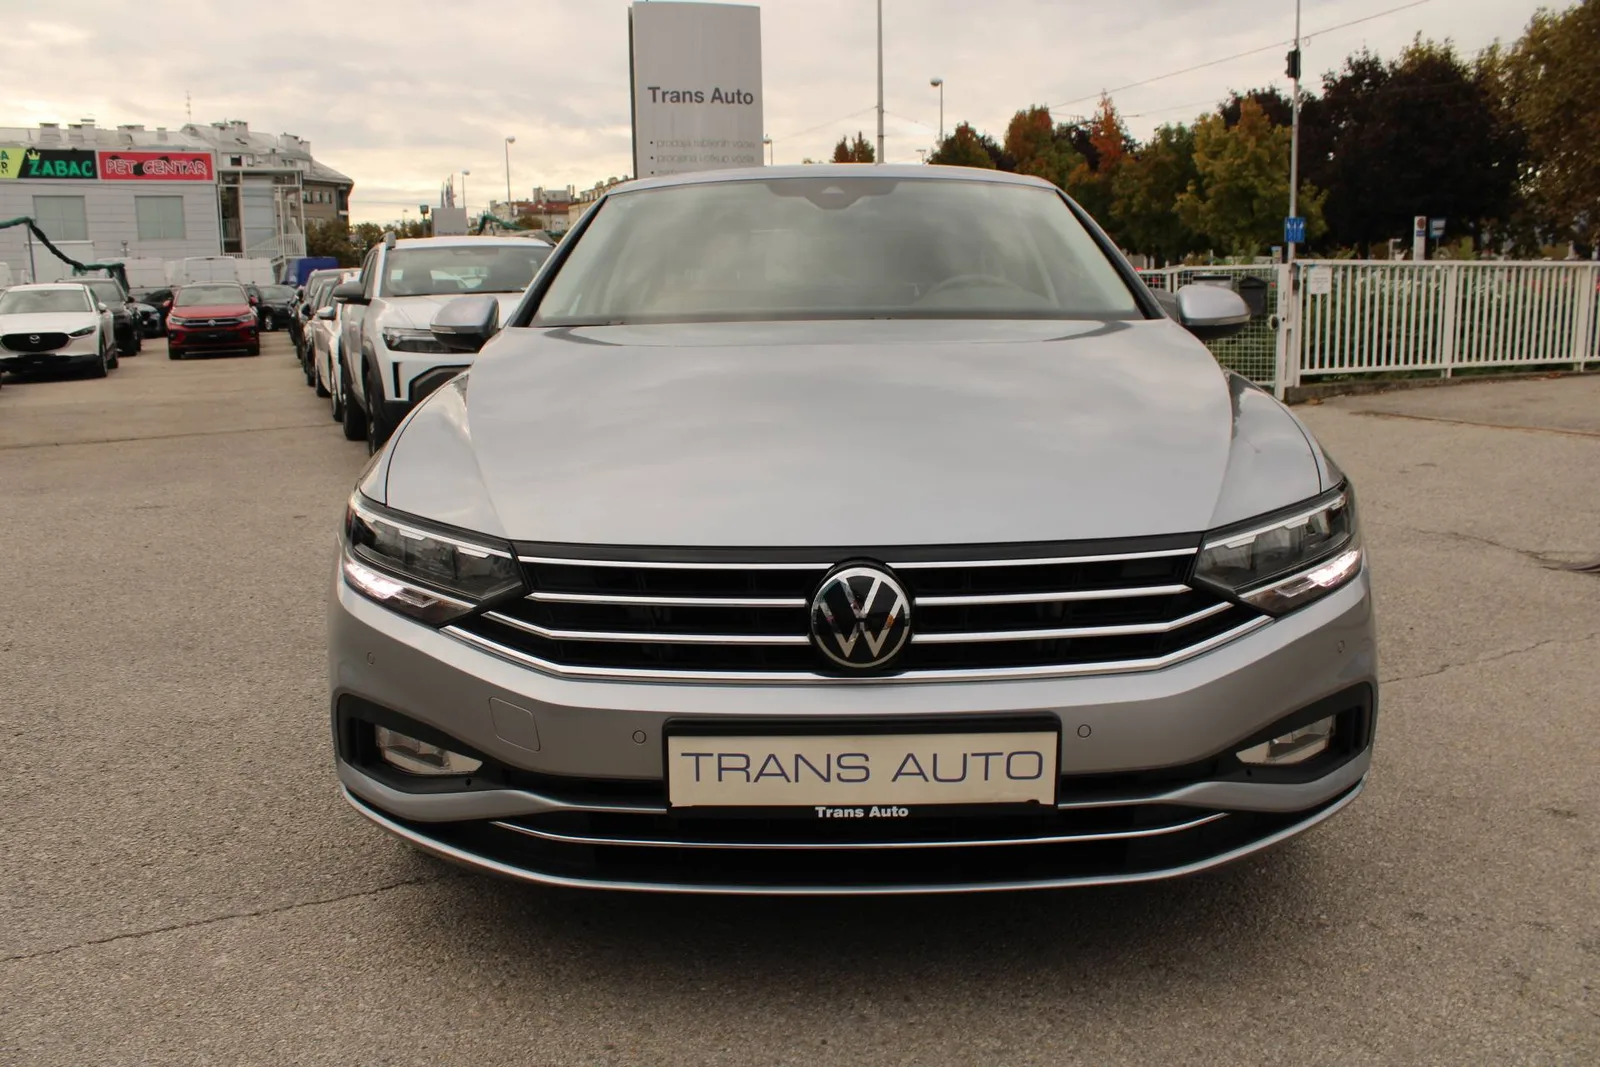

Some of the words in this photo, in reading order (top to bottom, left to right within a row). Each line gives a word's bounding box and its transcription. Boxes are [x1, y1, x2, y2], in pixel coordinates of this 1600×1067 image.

[647, 86, 705, 104] Trans
[710, 87, 754, 105] Auto
[106, 158, 136, 174] PET
[142, 159, 207, 175] CENTAR
[681, 752, 870, 783] TRANS
[891, 750, 1043, 783] AUTO
[815, 806, 864, 818] Trans
[868, 805, 909, 818] Auto
